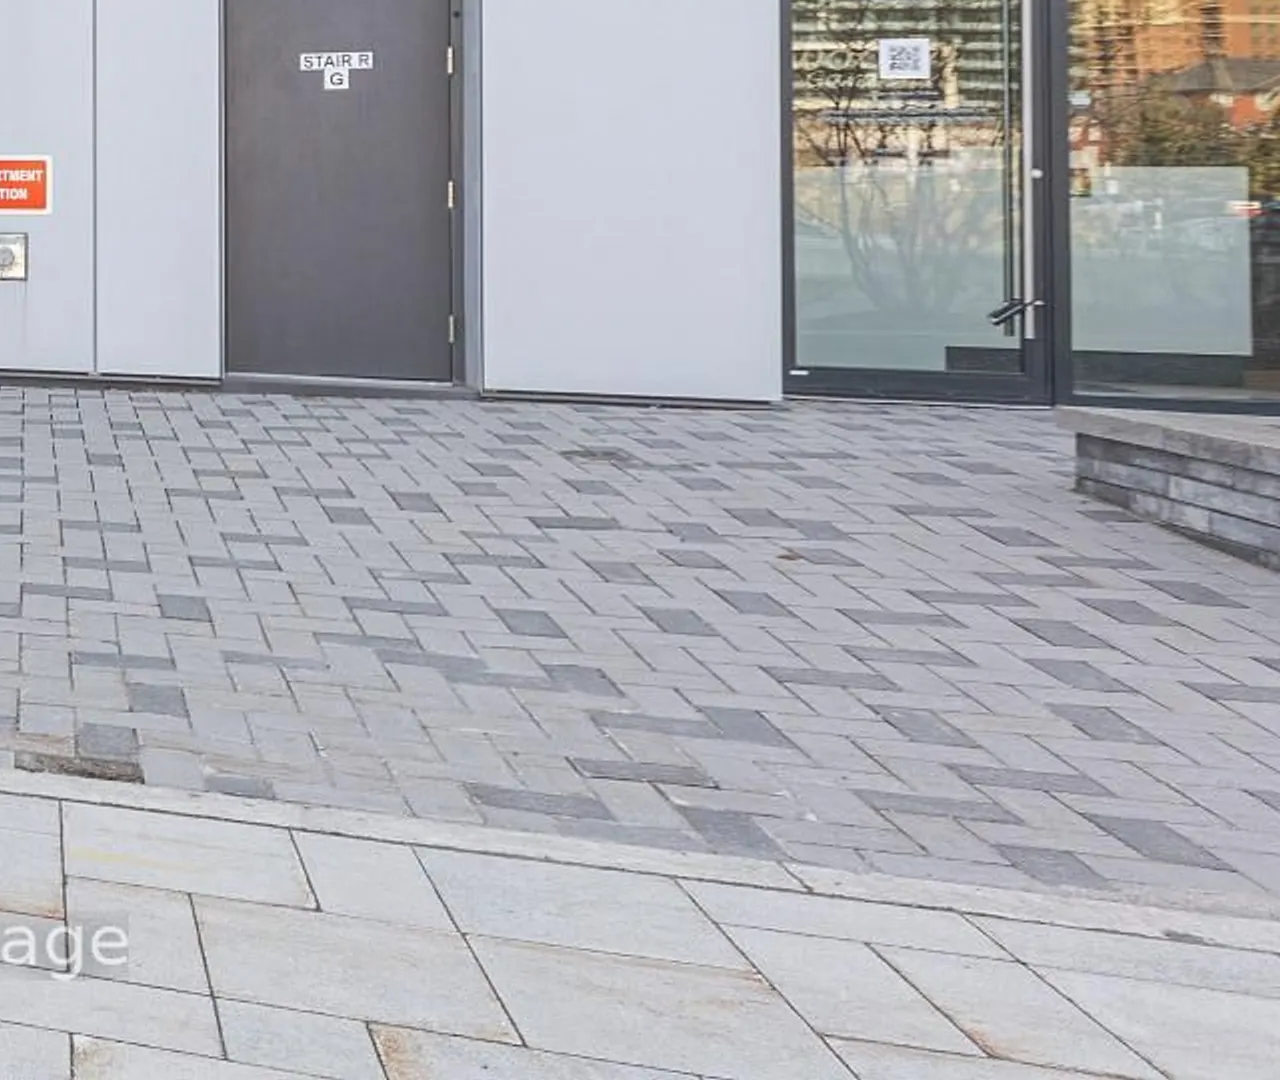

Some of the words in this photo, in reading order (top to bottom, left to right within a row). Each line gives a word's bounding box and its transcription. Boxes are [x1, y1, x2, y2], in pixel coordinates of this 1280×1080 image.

[304, 54, 352, 68] STAIR
[358, 54, 369, 67] R
[330, 72, 344, 85] G
